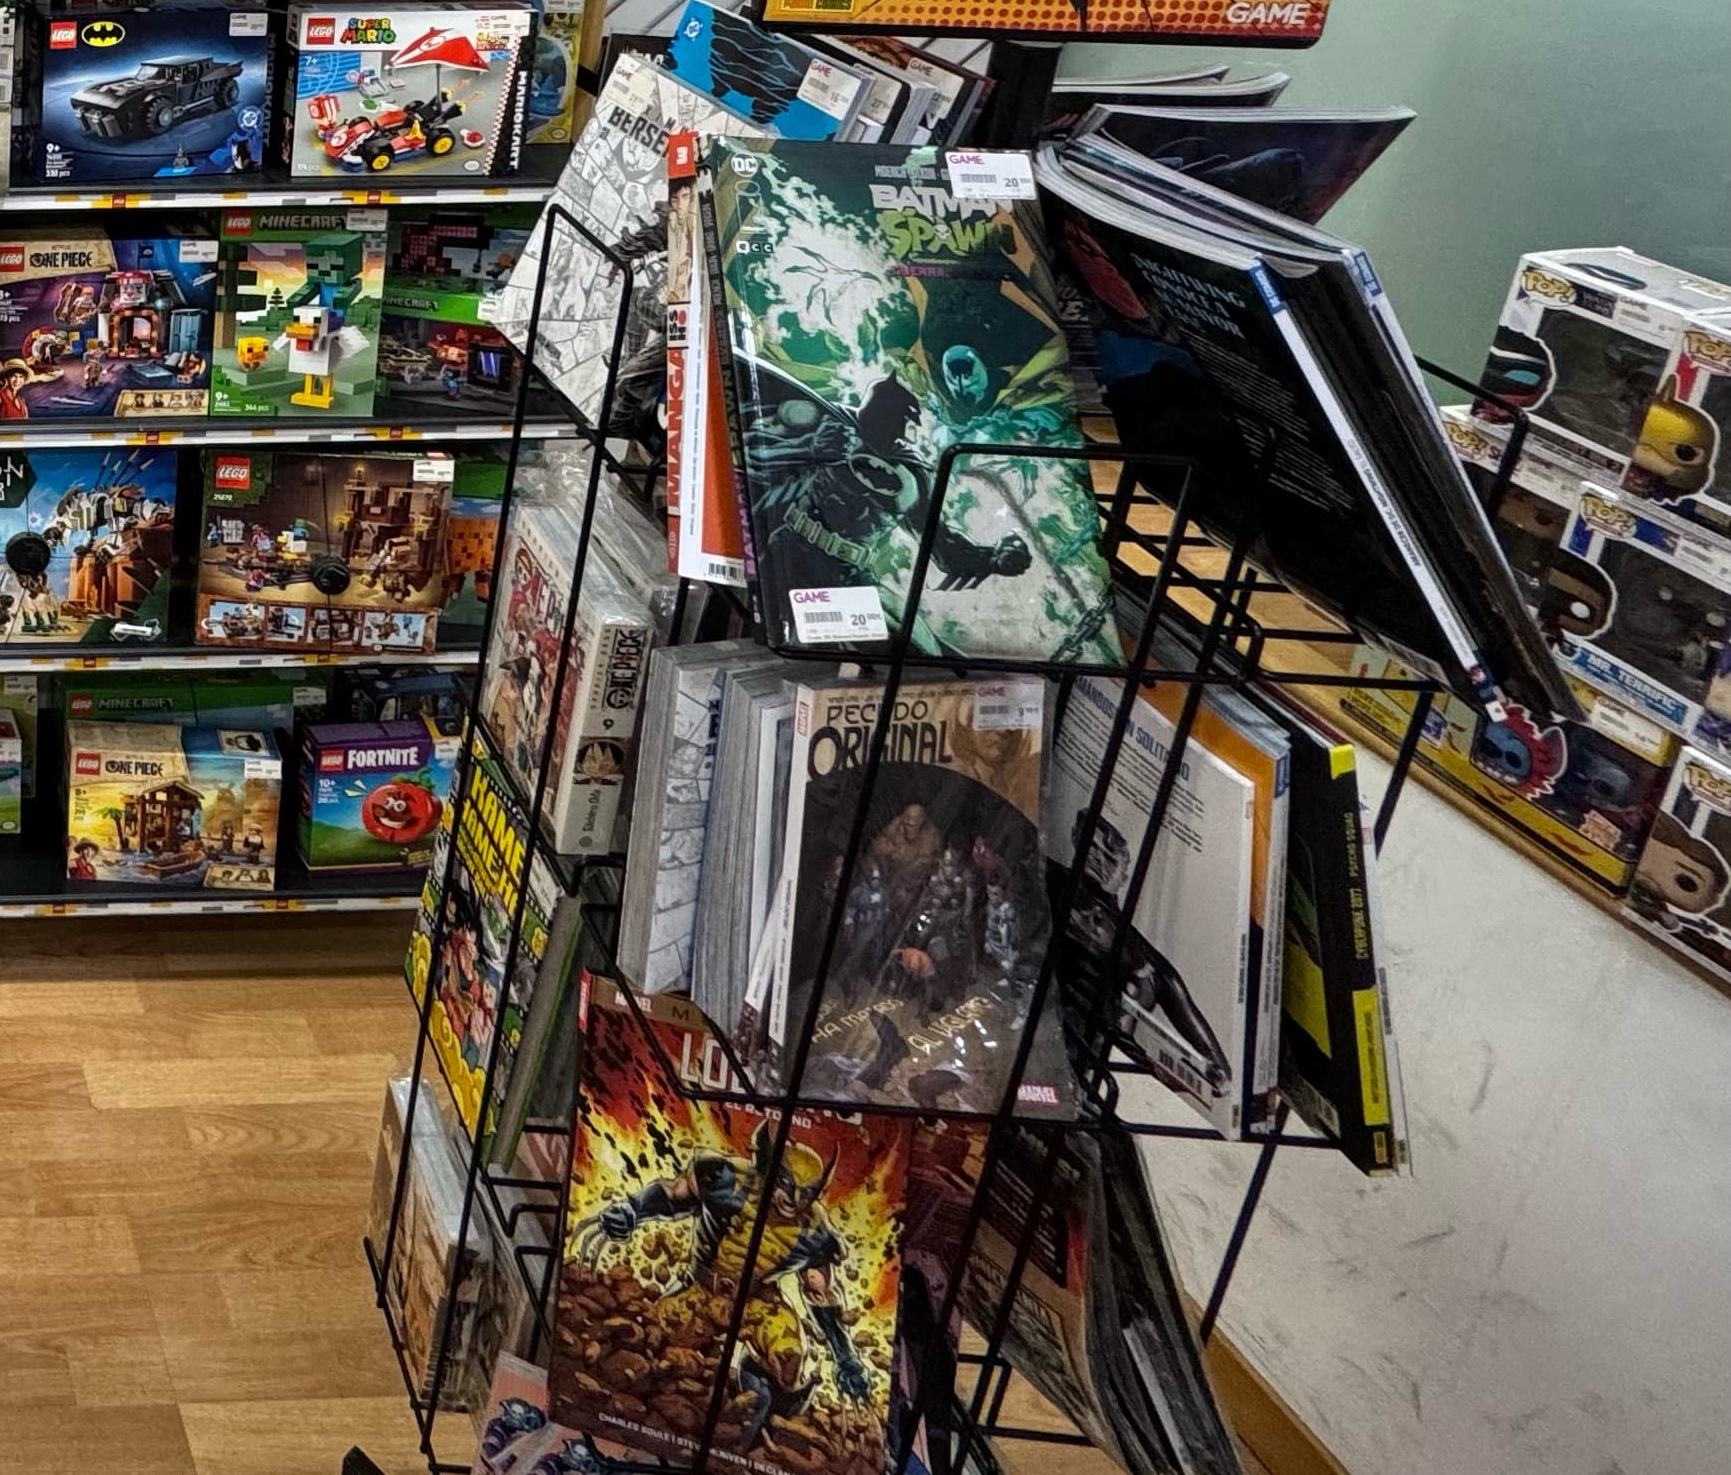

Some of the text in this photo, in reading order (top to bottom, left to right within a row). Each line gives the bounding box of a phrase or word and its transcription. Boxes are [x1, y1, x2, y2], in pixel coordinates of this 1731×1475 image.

[1226, 2, 1307, 24] GAME
[309, 24, 334, 38] LEGO
[349, 18, 391, 31] SUPER
[52, 29, 76, 41] LEGO
[341, 29, 395, 44] MARIO
[949, 155, 983, 164] GAME
[1005, 178, 1019, 187] 20
[869, 185, 1013, 220] BATMAN
[877, 208, 1017, 261] SPAWN
[30, 251, 92, 268] ONE PIECE
[792, 590, 831, 603] GAME
[851, 612, 867, 626] 20
[827, 700, 928, 725] PECDO
[348, 747, 418, 768] FORTNITE
[105, 760, 164, 776] ONE PIECE
[1018, 1086, 1058, 1103] MARVEL
